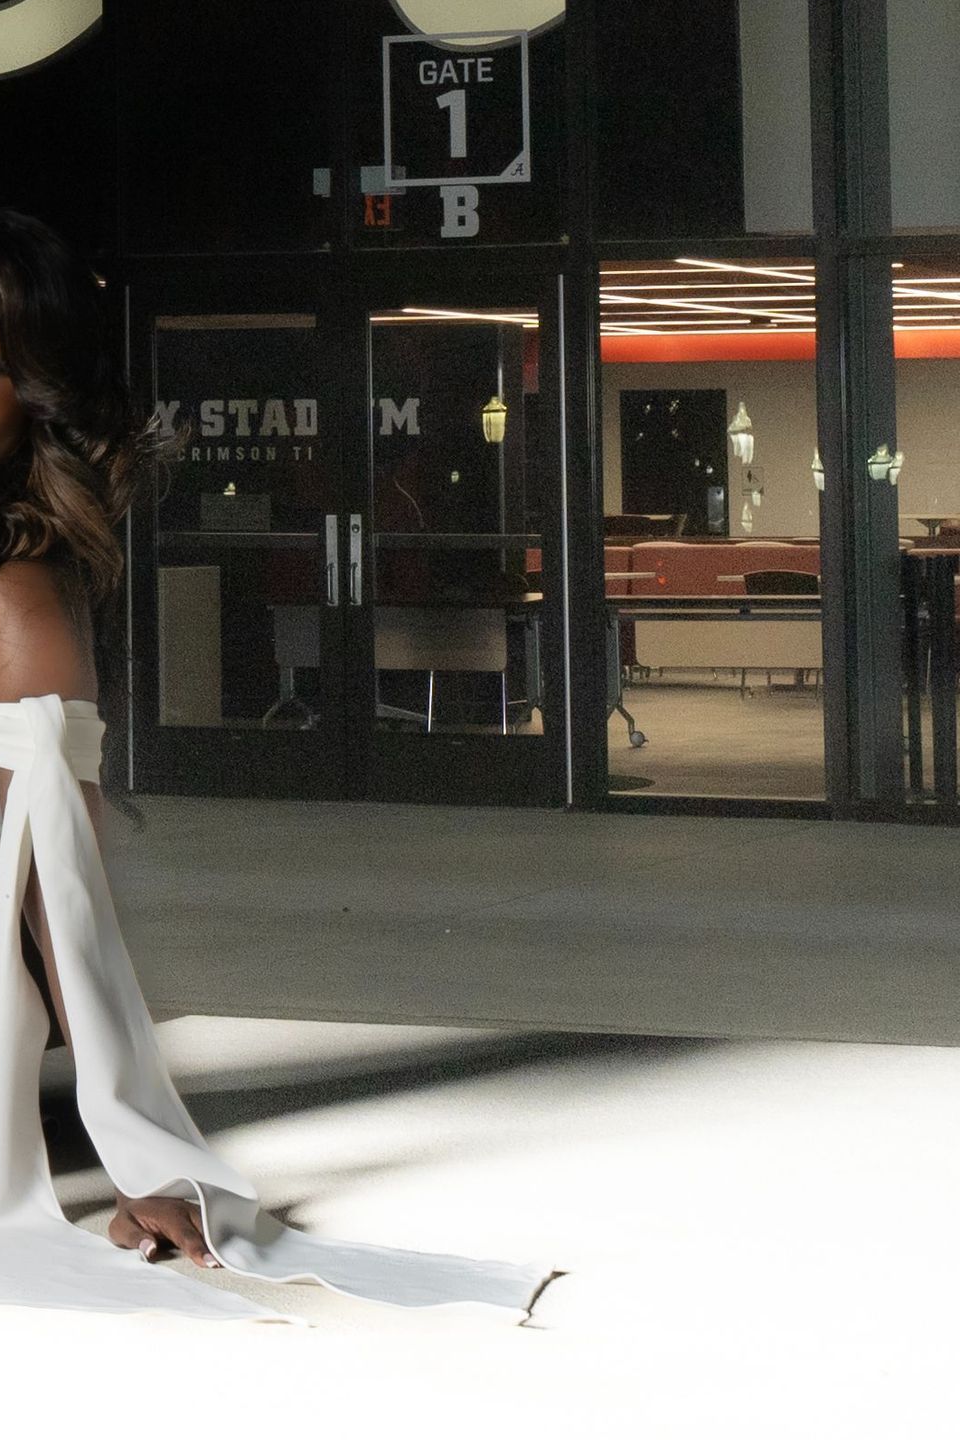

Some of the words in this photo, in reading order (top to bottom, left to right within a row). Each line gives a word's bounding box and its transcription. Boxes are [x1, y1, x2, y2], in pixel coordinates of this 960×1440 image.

[419, 58, 494, 85] GATE
[436, 89, 467, 158] 1
[440, 185, 479, 238] B
[200, 399, 421, 436] STADM
[294, 446, 313, 460] TI
